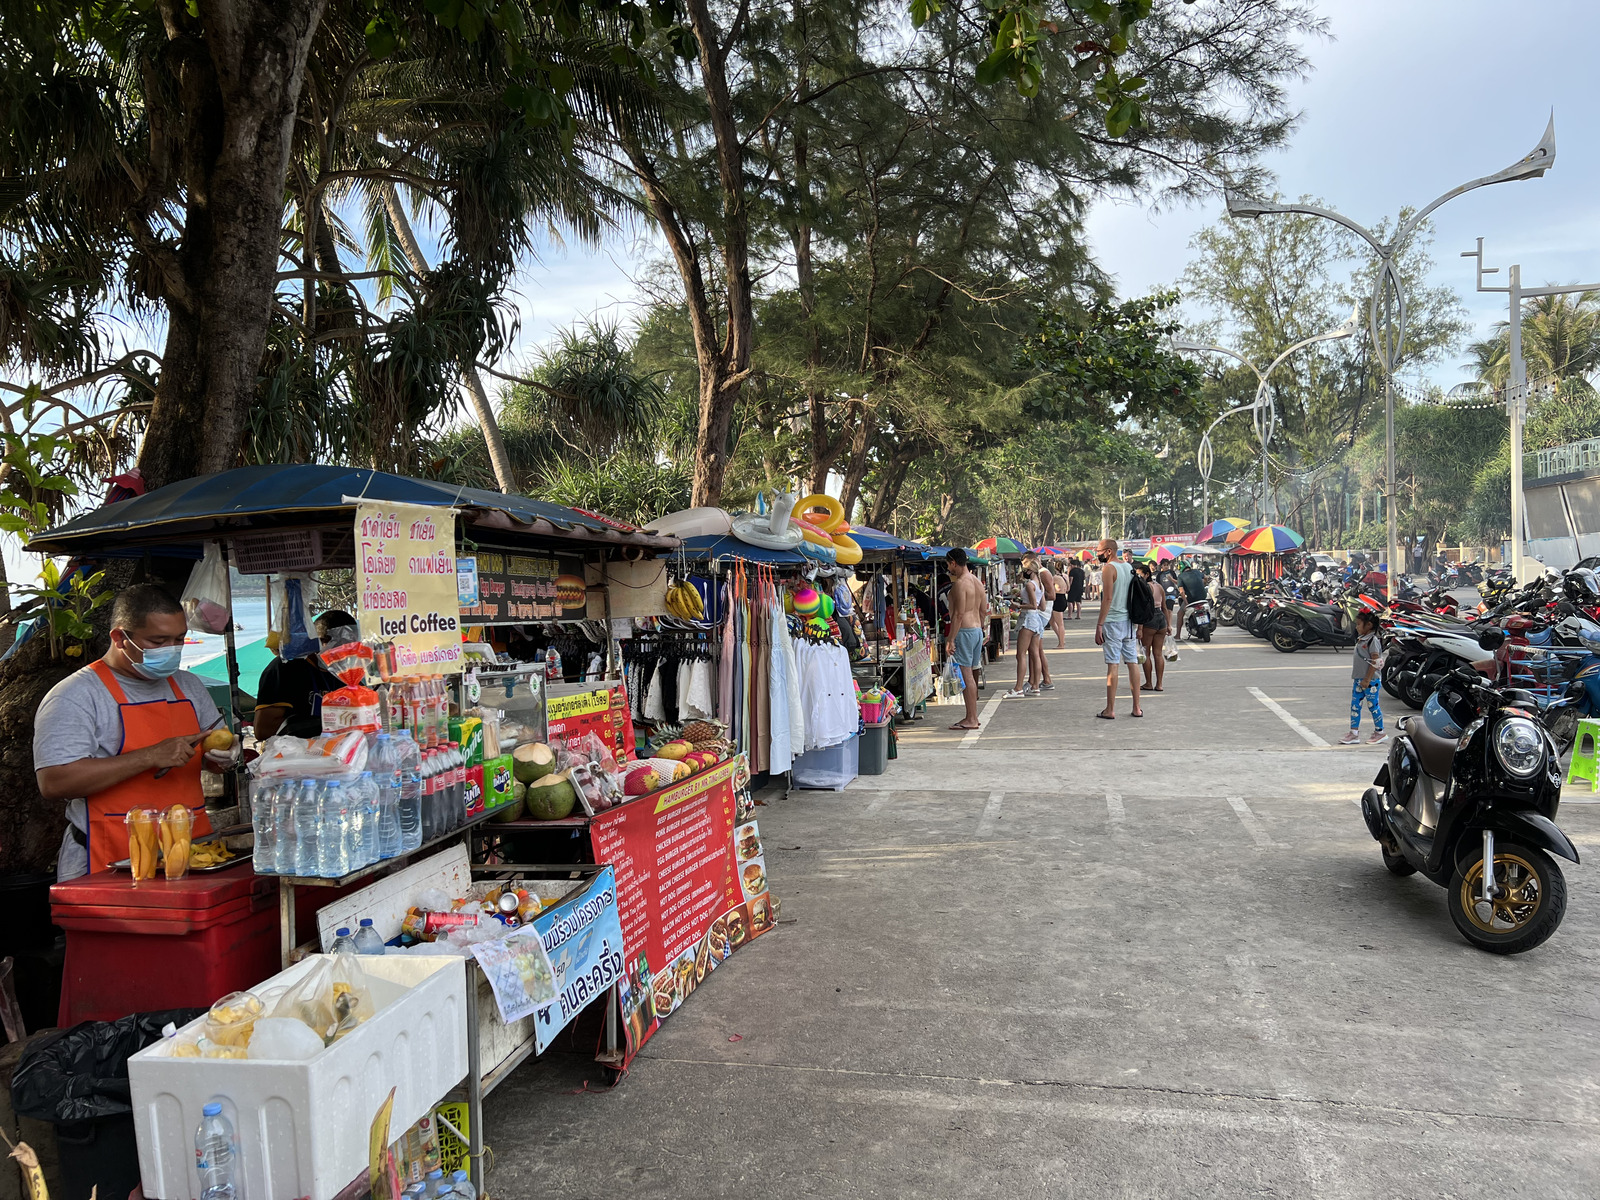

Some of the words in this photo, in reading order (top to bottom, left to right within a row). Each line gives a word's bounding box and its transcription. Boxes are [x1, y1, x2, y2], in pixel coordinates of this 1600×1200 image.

[361, 513, 400, 538] ชาดำเย็น
[410, 516, 436, 540] ชาเย็น
[409, 549, 453, 573] กาแฟเย็น
[363, 577, 407, 609] น้ำอ้อยสด
[380, 615, 406, 636] Iced
[410, 613, 456, 633] Coffee
[663, 783, 694, 806] HAMBURGER
[667, 807, 681, 820] BURGER
[656, 827, 666, 839] PORK
[666, 820, 681, 833] BURGER
[656, 839, 671, 852] CHICKEN
[672, 830, 685, 843] BURGER
[657, 854, 665, 866] EGG
[665, 848, 679, 861] BURGER
[658, 865, 672, 879] CHEESE
[672, 856, 686, 871] BURGER
[659, 878, 672, 893] BACON
[672, 871, 685, 886] CHEESE
[685, 862, 698, 876] BURGER
[660, 896, 668, 907] HOT
[668, 890, 676, 904] DOG
[661, 910, 669, 921] HOT
[669, 903, 677, 915] DOG
[677, 894, 691, 909] CHEESE
[662, 920, 675, 935] BACON
[675, 914, 683, 927] HOT
[683, 907, 692, 920] DOG
[664, 933, 676, 949] BACON
[676, 921, 691, 938] CHEESE
[691, 915, 699, 927] HOT
[699, 910, 709, 922] DOG
[665, 949, 674, 962] BBQ
[674, 941, 683, 955] BEEF
[683, 935, 692, 948] HOT
[692, 929, 701, 941] DOG
[559, 938, 623, 1021] คนละครึ่ง
